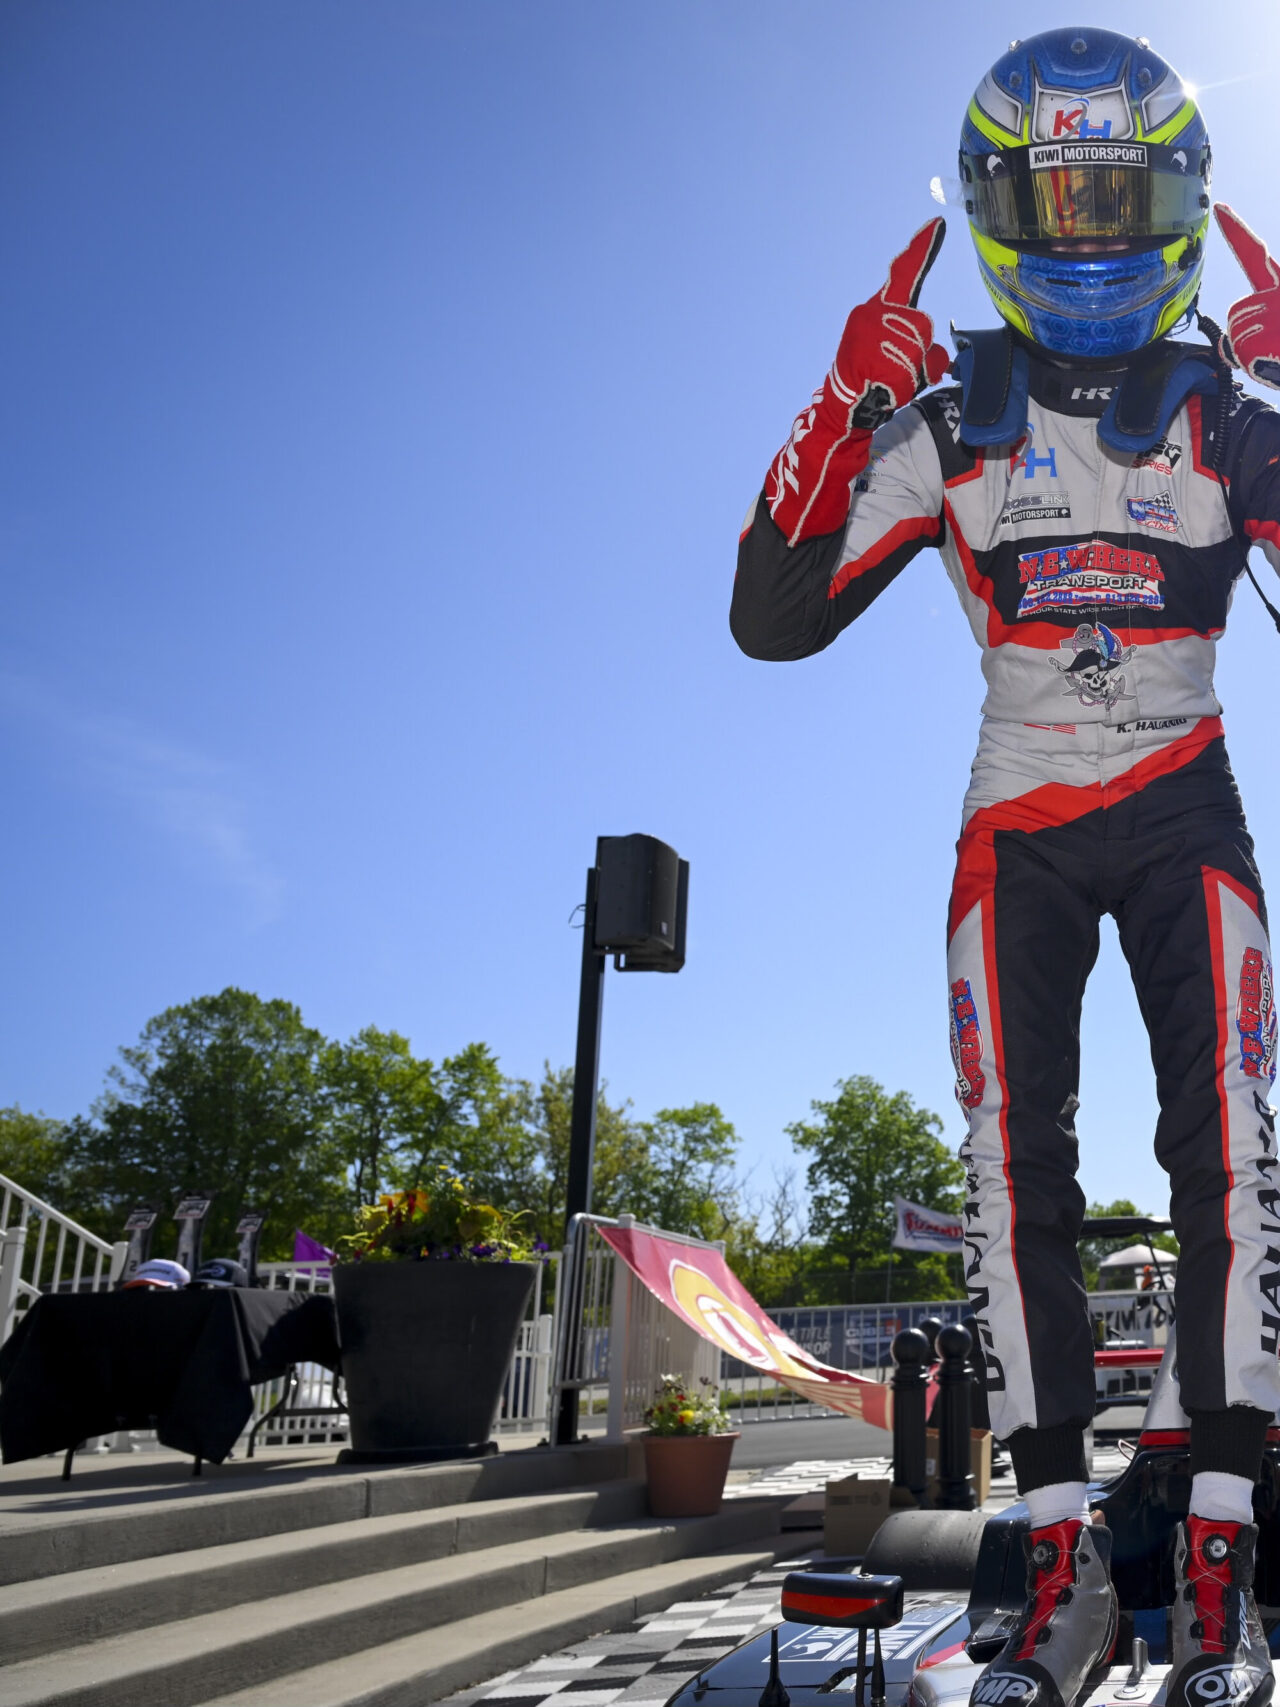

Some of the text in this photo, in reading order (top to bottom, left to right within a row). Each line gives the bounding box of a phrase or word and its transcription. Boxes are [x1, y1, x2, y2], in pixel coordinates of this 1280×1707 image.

[1034, 147, 1143, 163] KIWI MOTORSPORT
[1071, 387, 1113, 400] HR
[1012, 509, 1059, 522] MOTORSPORT
[1034, 575, 1147, 591] TRANSPORT
[1053, 607, 1077, 615] STATE
[1117, 723, 1131, 733] K.
